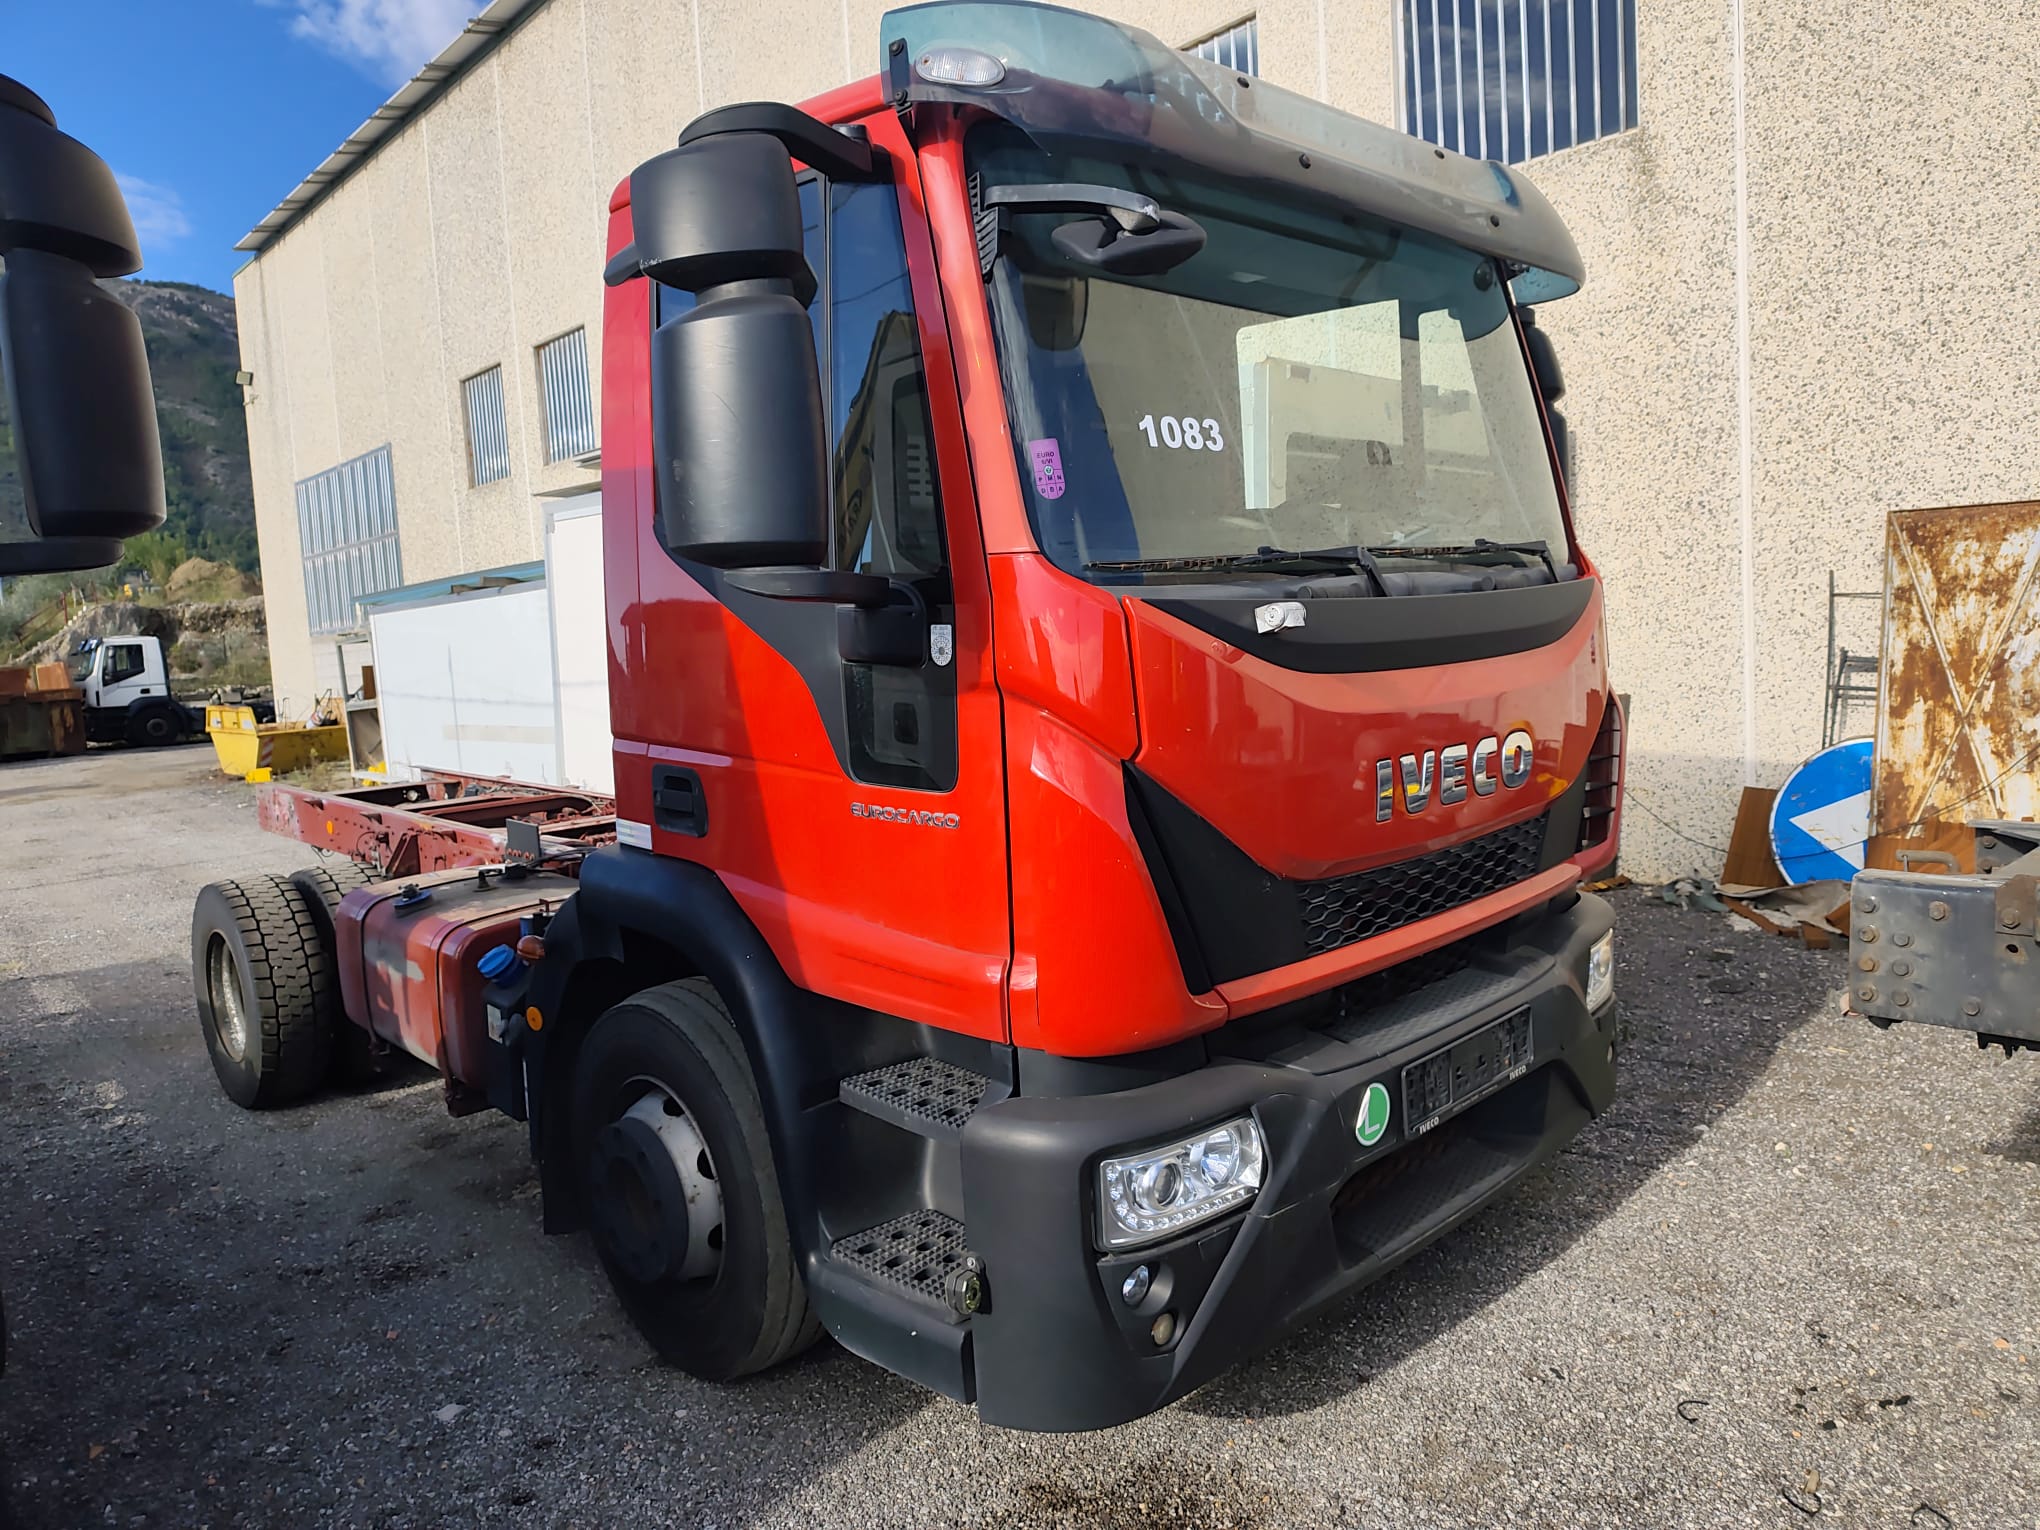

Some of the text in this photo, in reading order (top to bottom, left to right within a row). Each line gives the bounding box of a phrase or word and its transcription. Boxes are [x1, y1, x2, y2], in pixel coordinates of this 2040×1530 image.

[1139, 415, 1224, 451] 1083
[1036, 451, 1055, 459] EURO
[1376, 730, 1533, 823] IVECO
[850, 802, 960, 829] EUROCARGO
[1509, 1064, 1527, 1080] IVECO
[1362, 1098, 1381, 1135] L
[1419, 1116, 1440, 1135] IVECO
